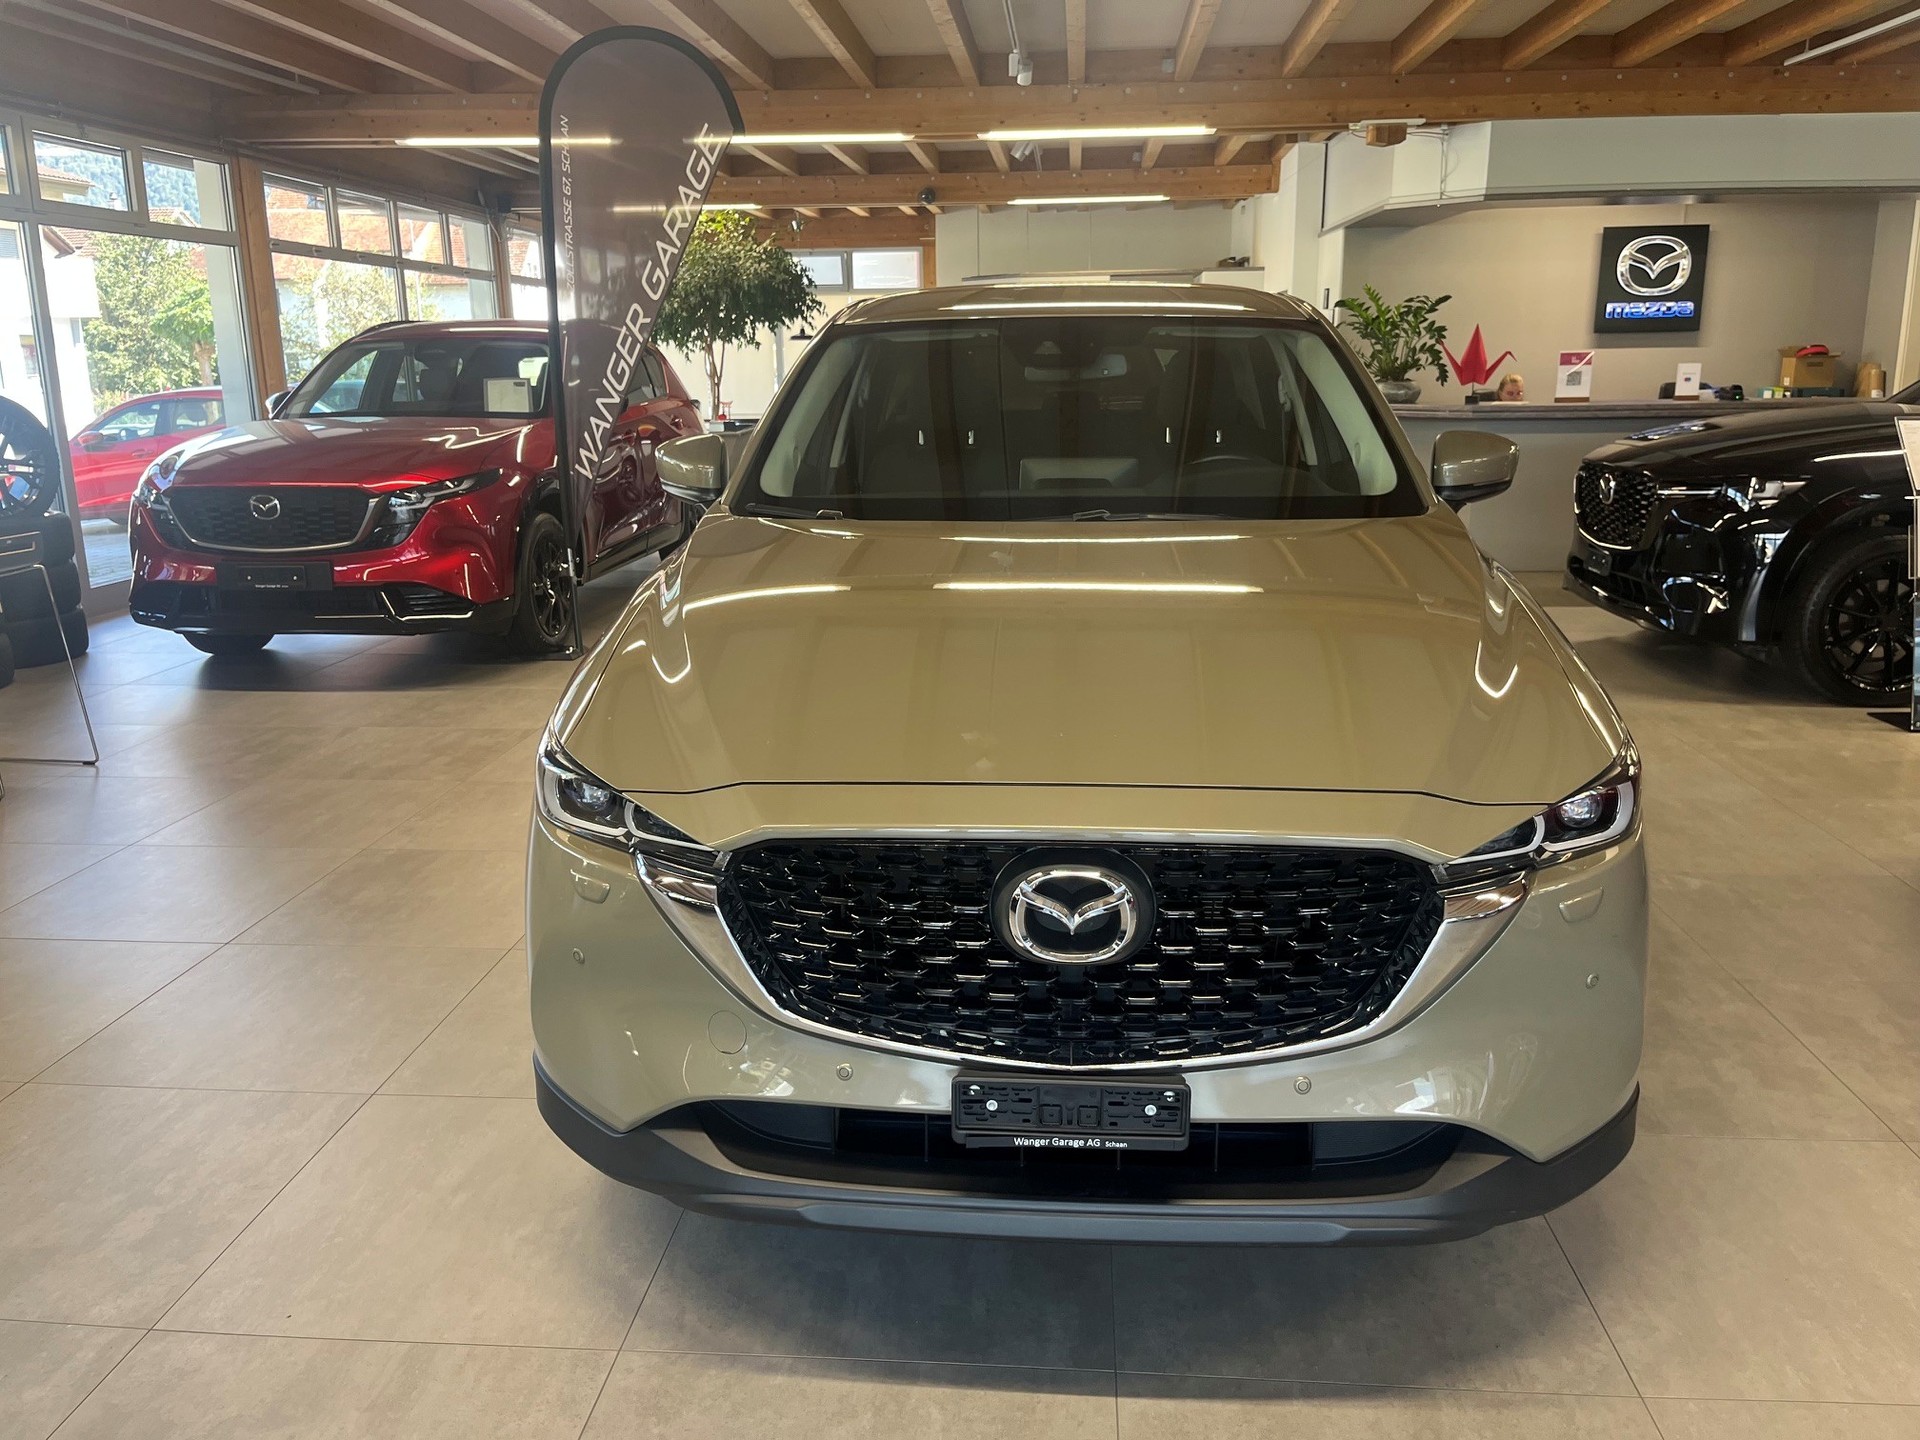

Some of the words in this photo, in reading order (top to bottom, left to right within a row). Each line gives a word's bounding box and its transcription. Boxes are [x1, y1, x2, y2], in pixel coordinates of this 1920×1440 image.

[562, 177, 573, 195] 67,
[563, 196, 575, 290] ZOLLSTRASSE
[574, 303, 651, 481] WANGER
[641, 122, 722, 301] GARAGE
[1013, 1137, 1050, 1148] Wanger
[1051, 1138, 1085, 1148] Garage
[1086, 1138, 1101, 1147] AG
